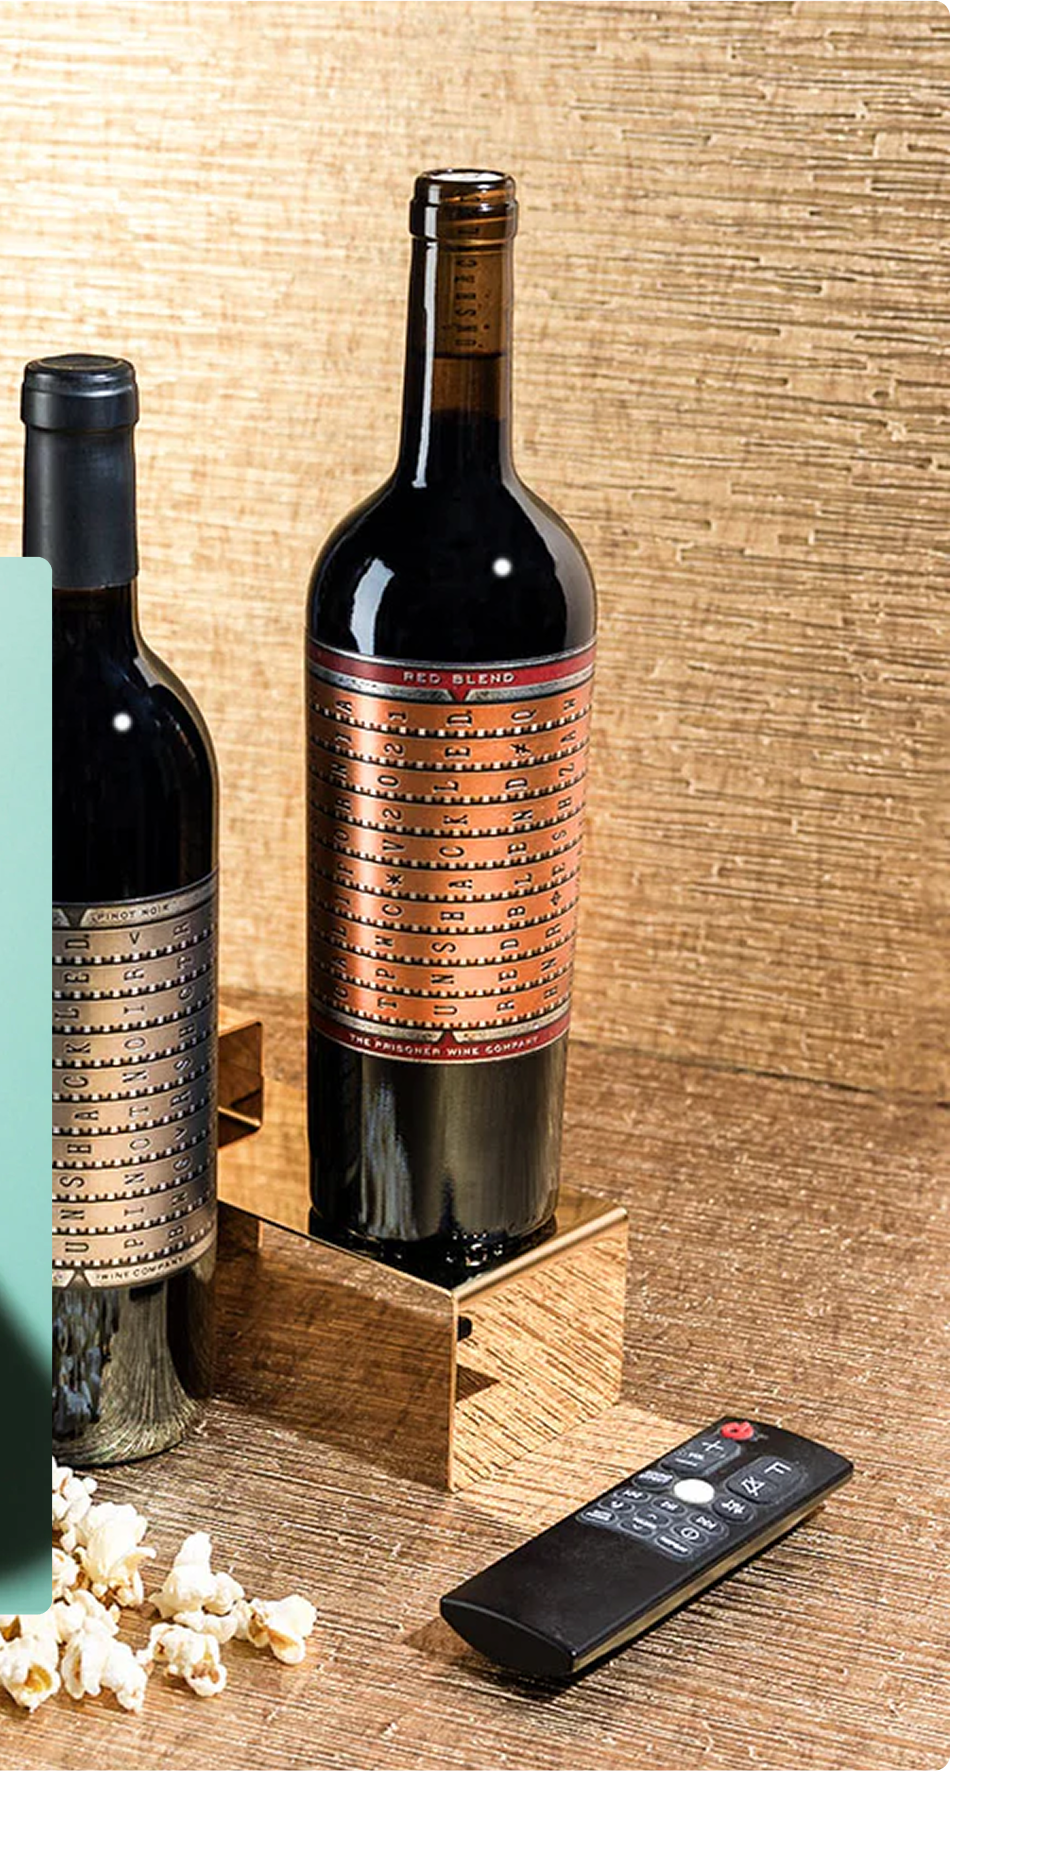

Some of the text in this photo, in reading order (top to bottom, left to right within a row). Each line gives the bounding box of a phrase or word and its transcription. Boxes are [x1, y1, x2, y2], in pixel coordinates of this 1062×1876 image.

[403, 671, 515, 686] RED BLEND
[97, 911, 135, 922] PINOT
[349, 1033, 539, 1057] THE PRISONER WINE COMPANY
